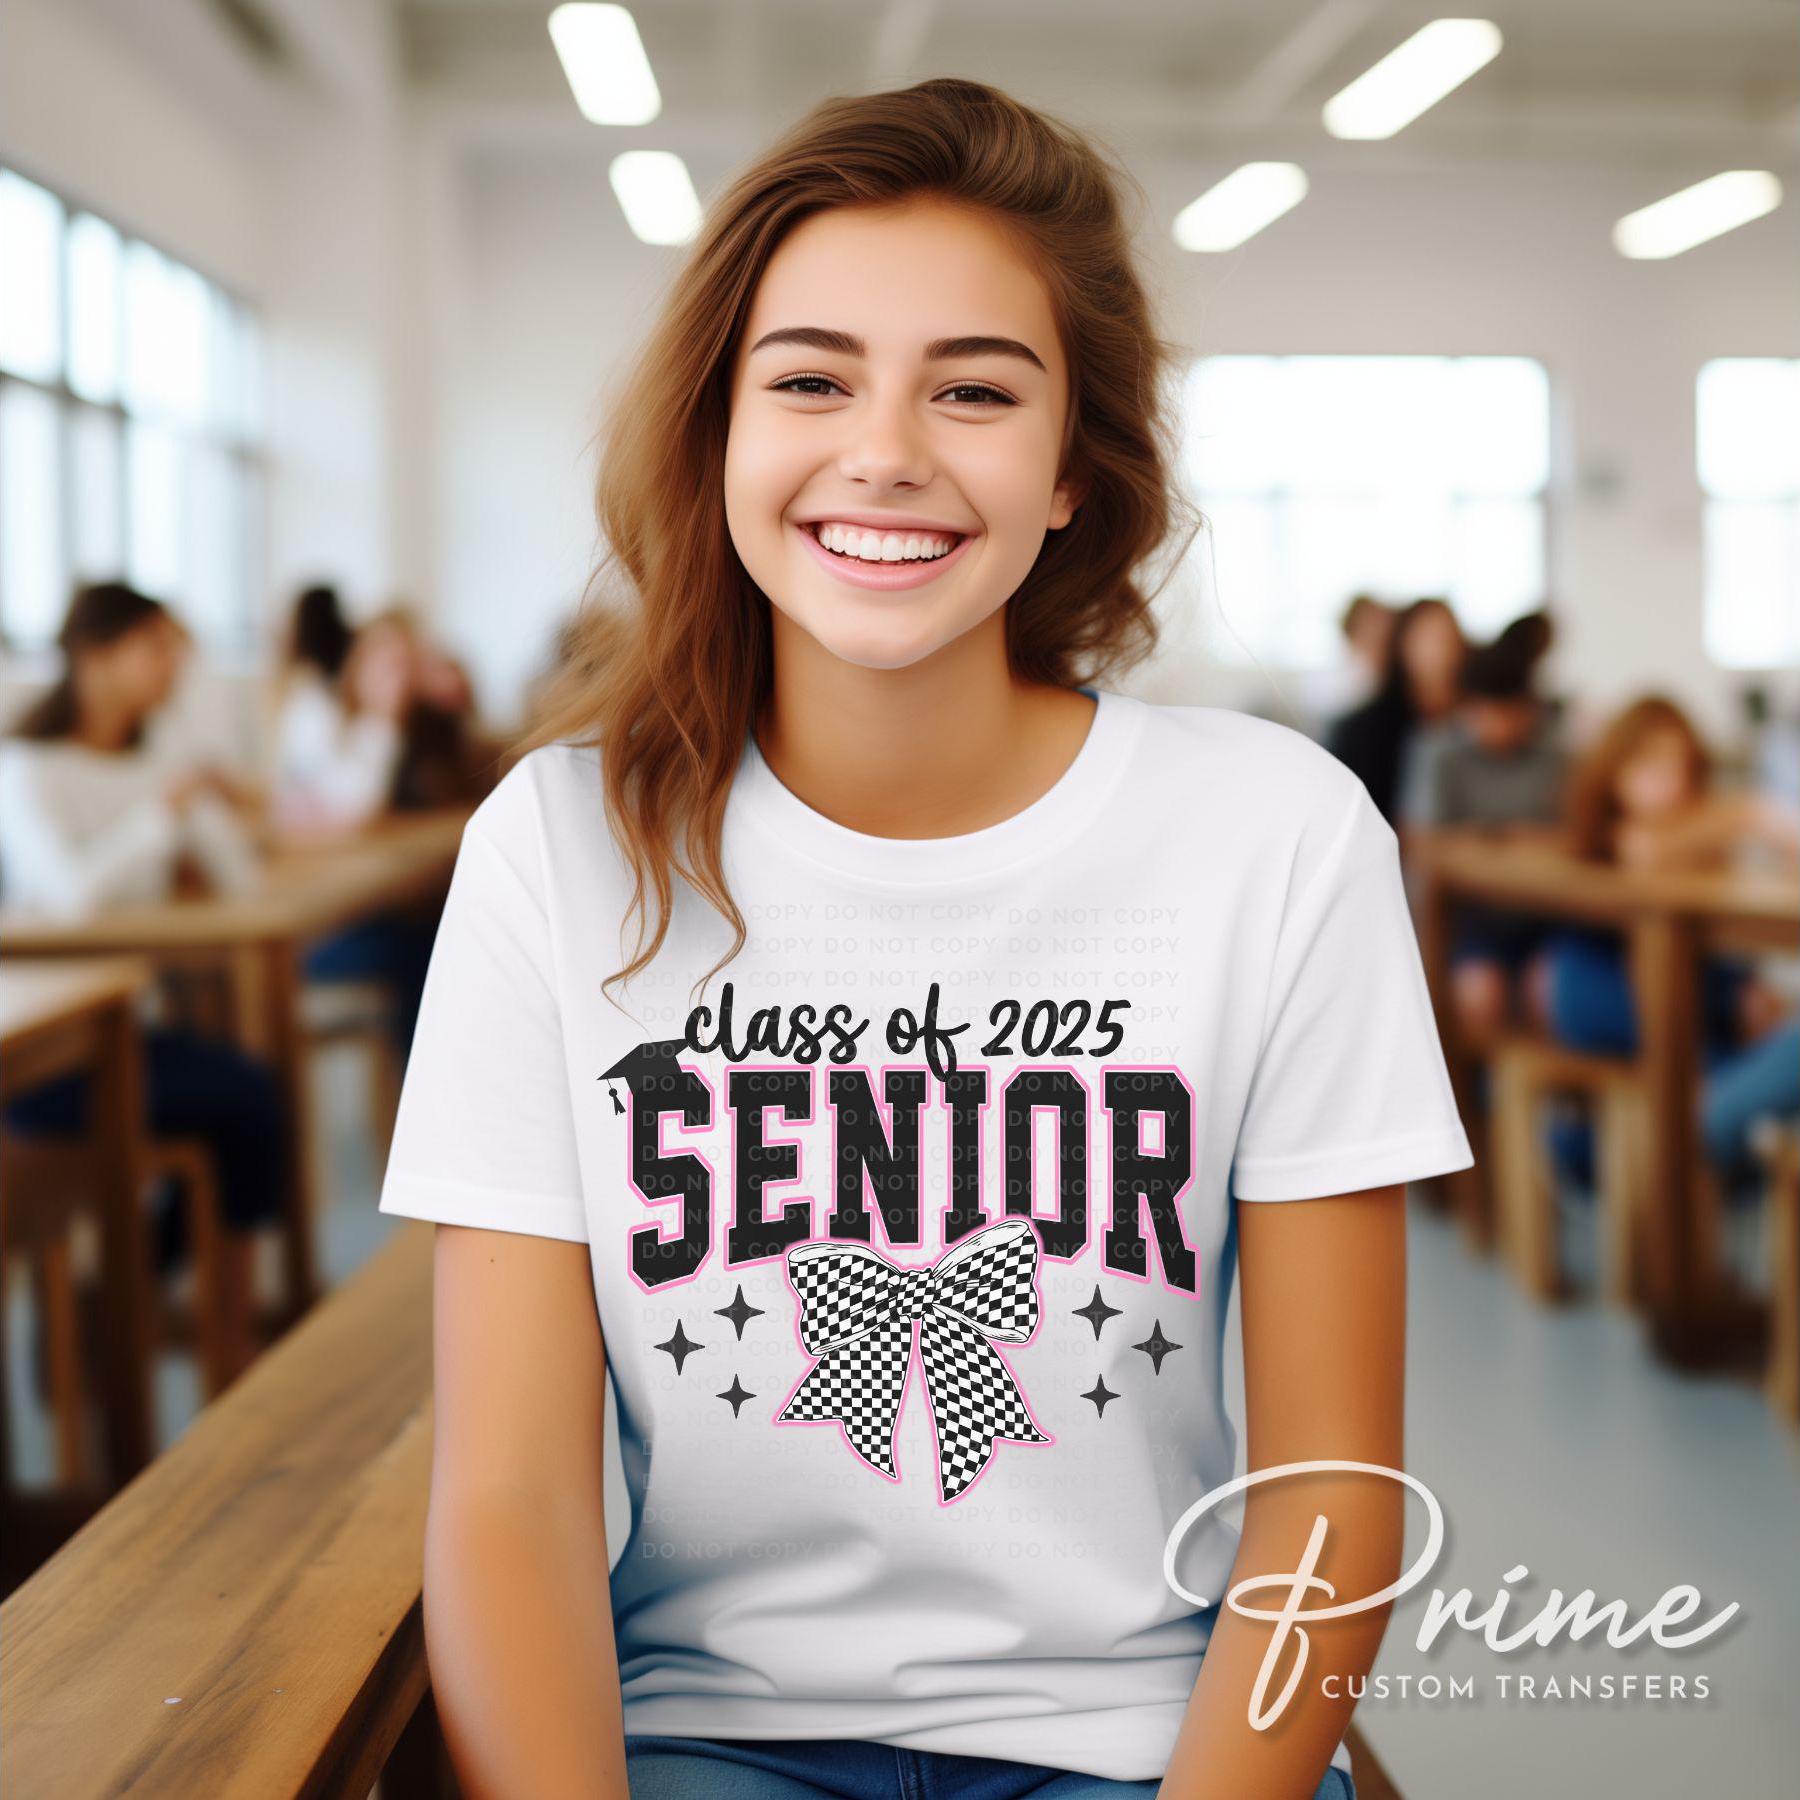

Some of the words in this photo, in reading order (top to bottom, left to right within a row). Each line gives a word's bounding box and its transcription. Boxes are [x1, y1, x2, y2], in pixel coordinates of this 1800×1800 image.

[684, 982, 870, 1064] class
[886, 982, 971, 1082] of
[980, 999, 1132, 1058] 2025
[627, 1064, 1199, 1298] SENIOR
